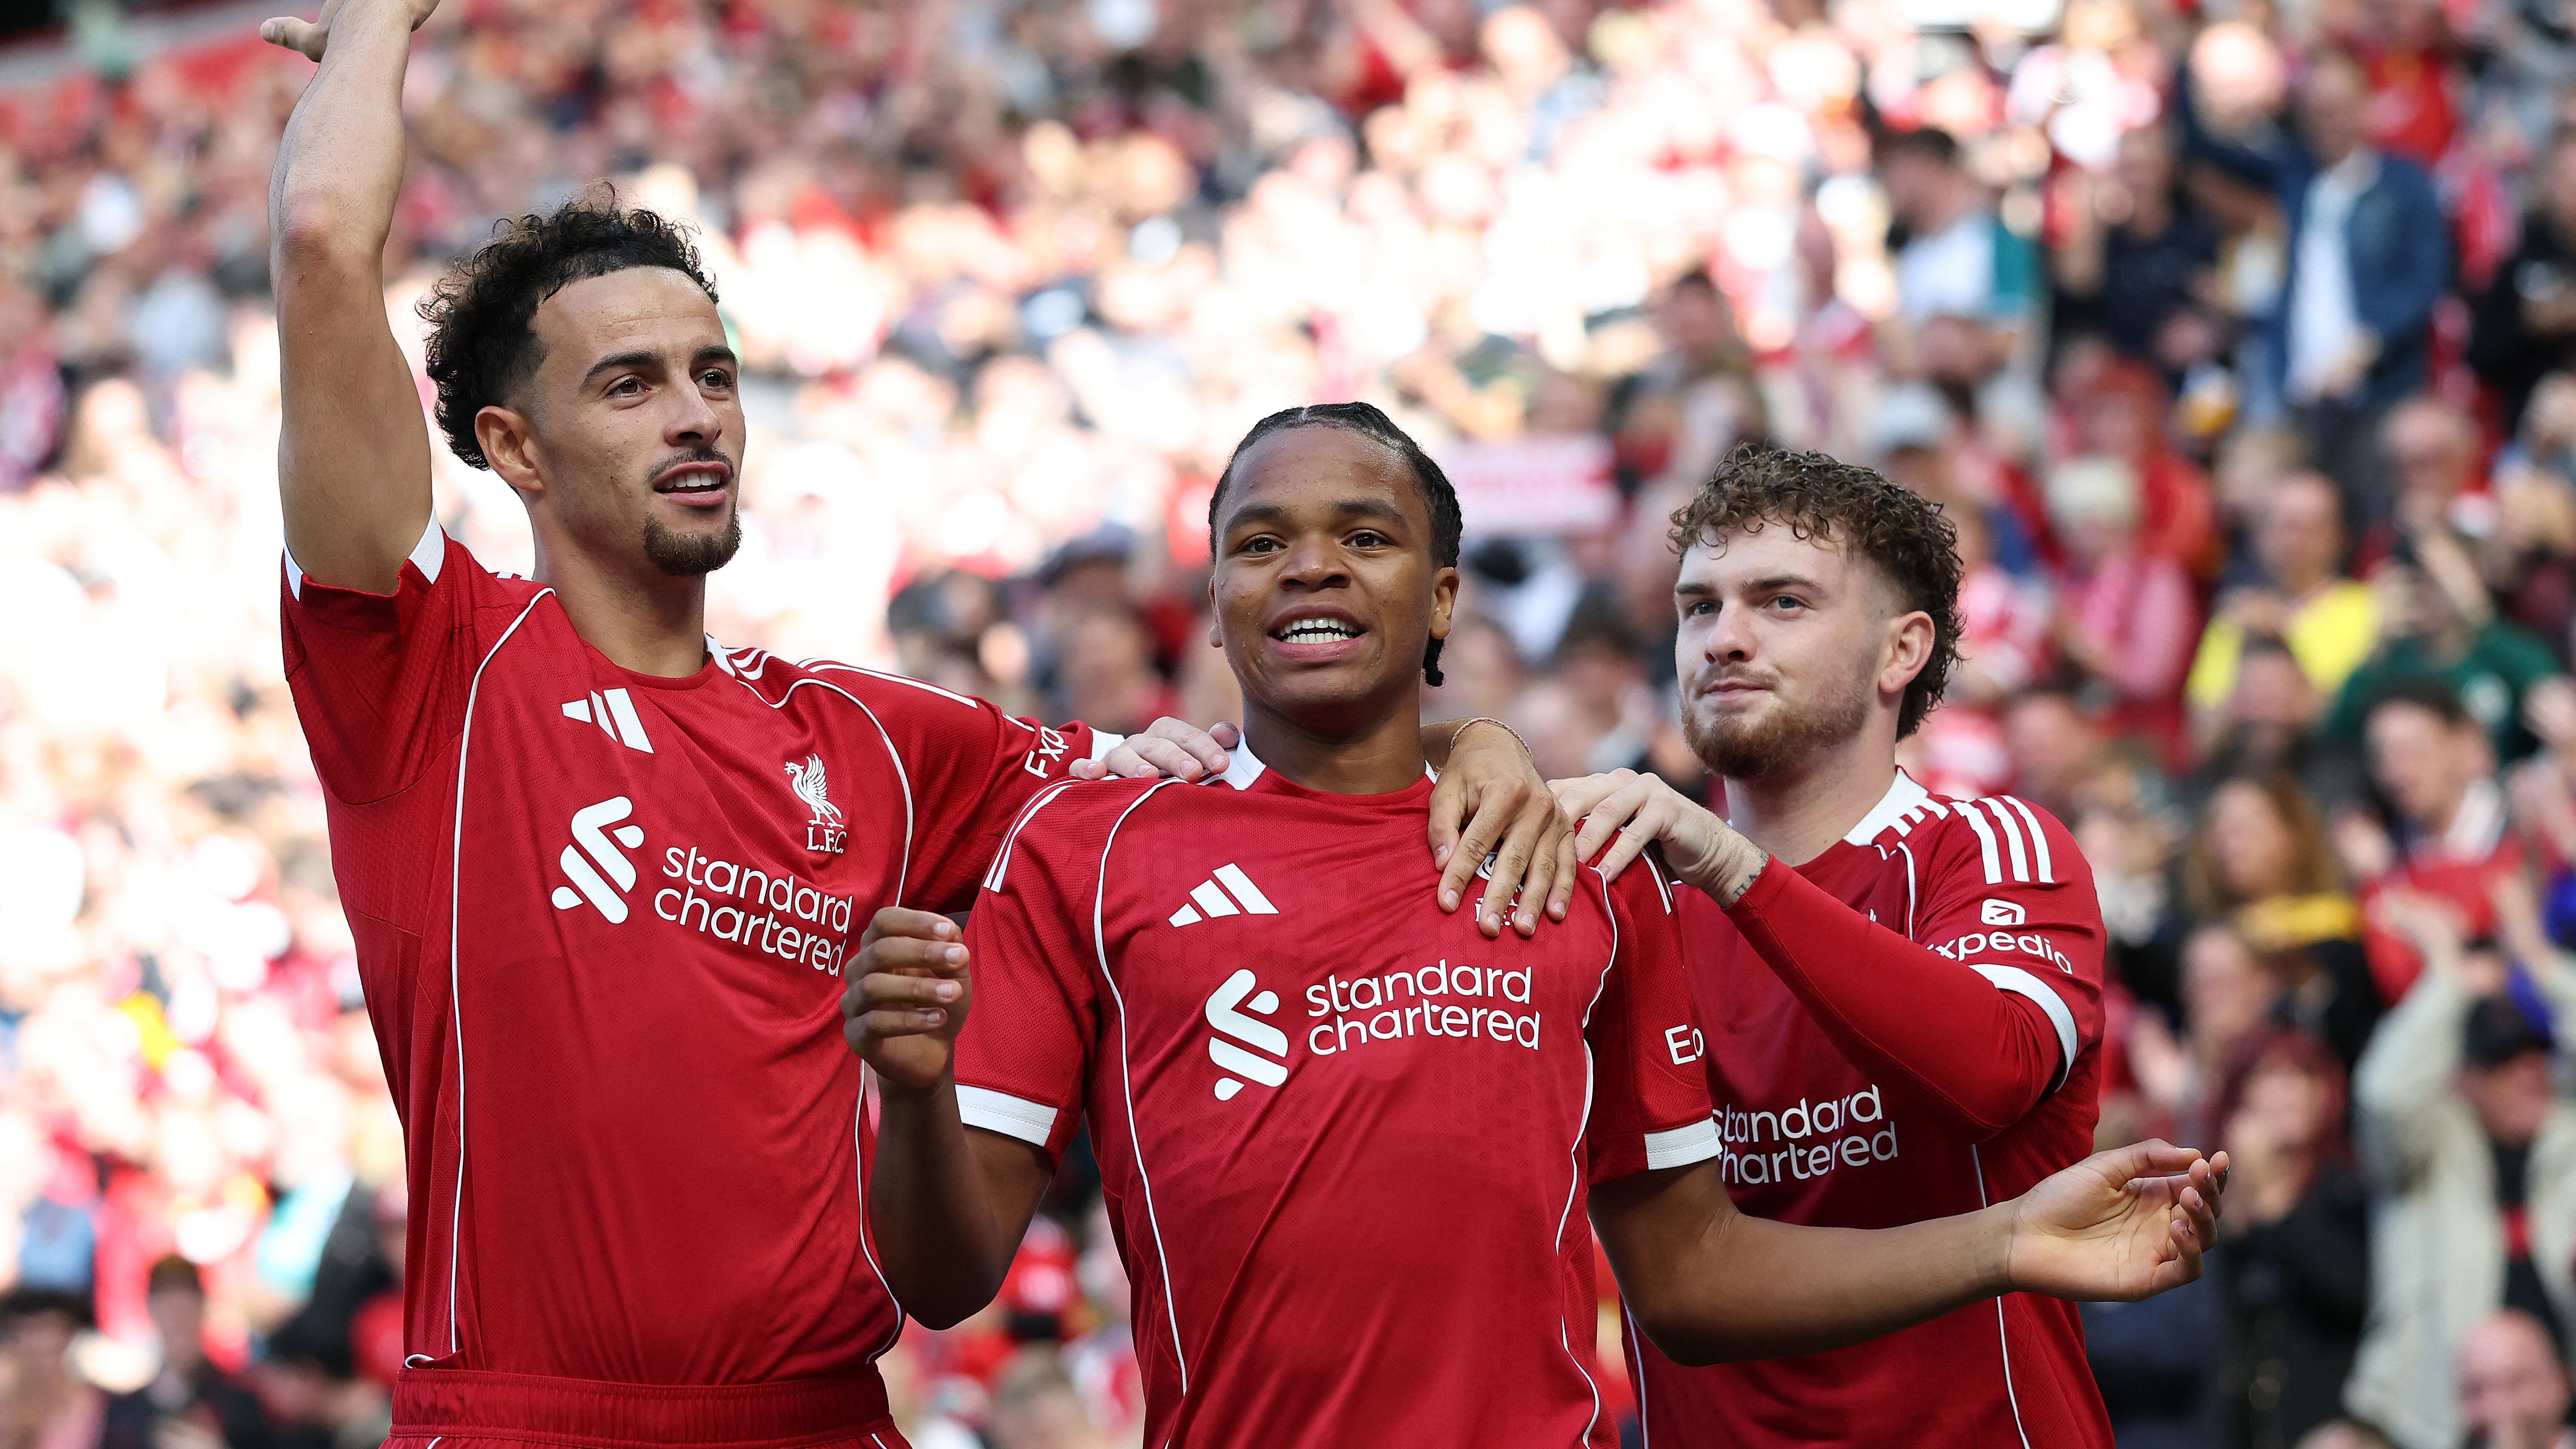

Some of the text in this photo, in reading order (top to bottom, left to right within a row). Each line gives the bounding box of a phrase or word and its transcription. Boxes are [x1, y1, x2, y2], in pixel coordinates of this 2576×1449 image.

[663, 846, 853, 934] standard
[654, 885, 846, 977] chartered
[1927, 931, 2073, 975] xpedia
[1306, 959, 1532, 1017] standard
[1309, 998, 1540, 1055] chartered
[1713, 1084, 1883, 1143] standard
[1718, 1121, 1898, 1184] hartered
